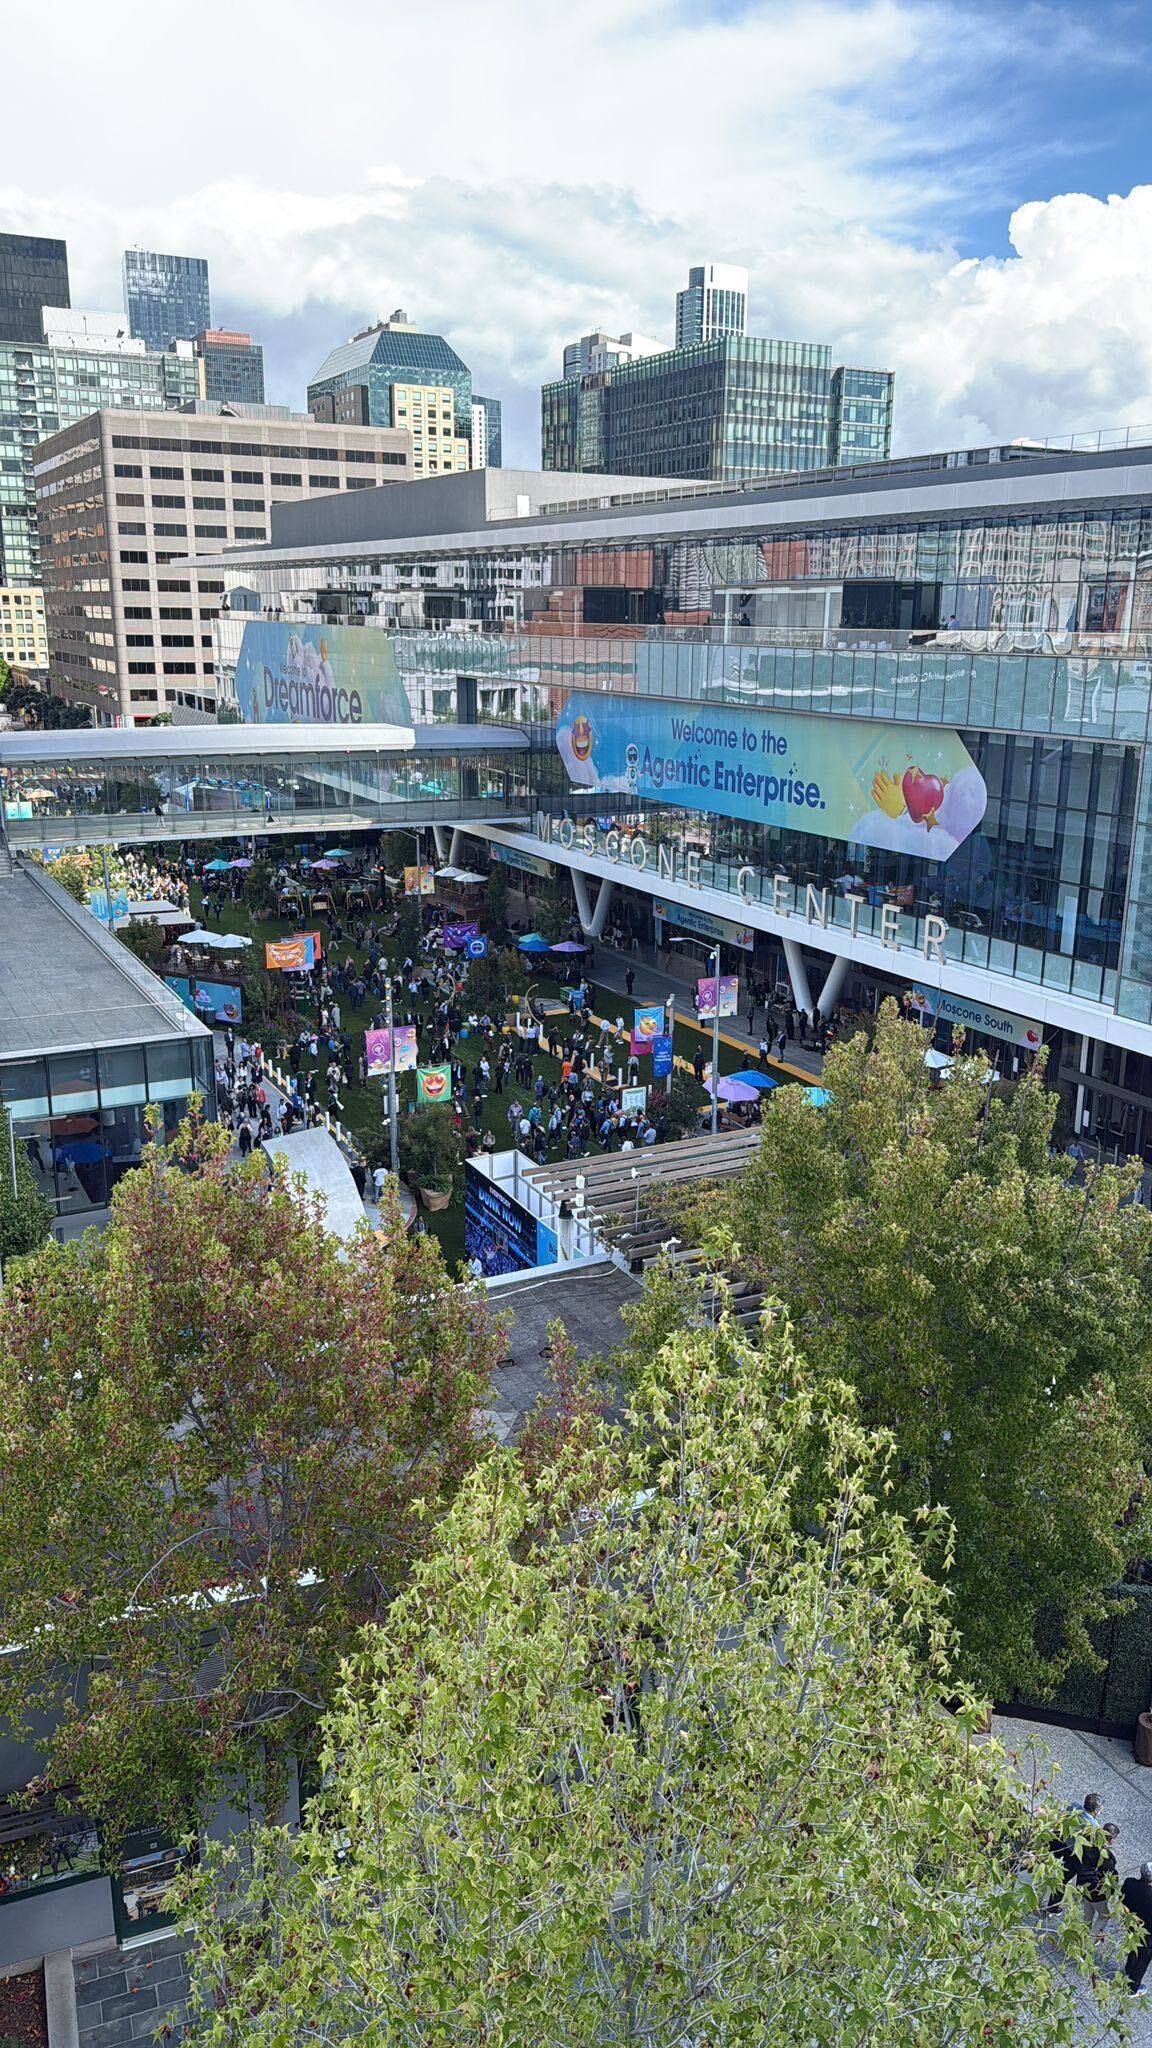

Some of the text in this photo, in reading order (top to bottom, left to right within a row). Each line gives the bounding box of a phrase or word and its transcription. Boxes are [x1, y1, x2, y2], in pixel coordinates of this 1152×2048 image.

[264, 666, 362, 723] Dreamforce
[671, 718, 787, 755] Welcome to the
[640, 745, 825, 809] Agentic Enterprise.
[536, 810, 950, 965] MOSCONE CENTER
[677, 913, 724, 937] Agentic Enterprise
[937, 1000, 1013, 1034] Moscone South
